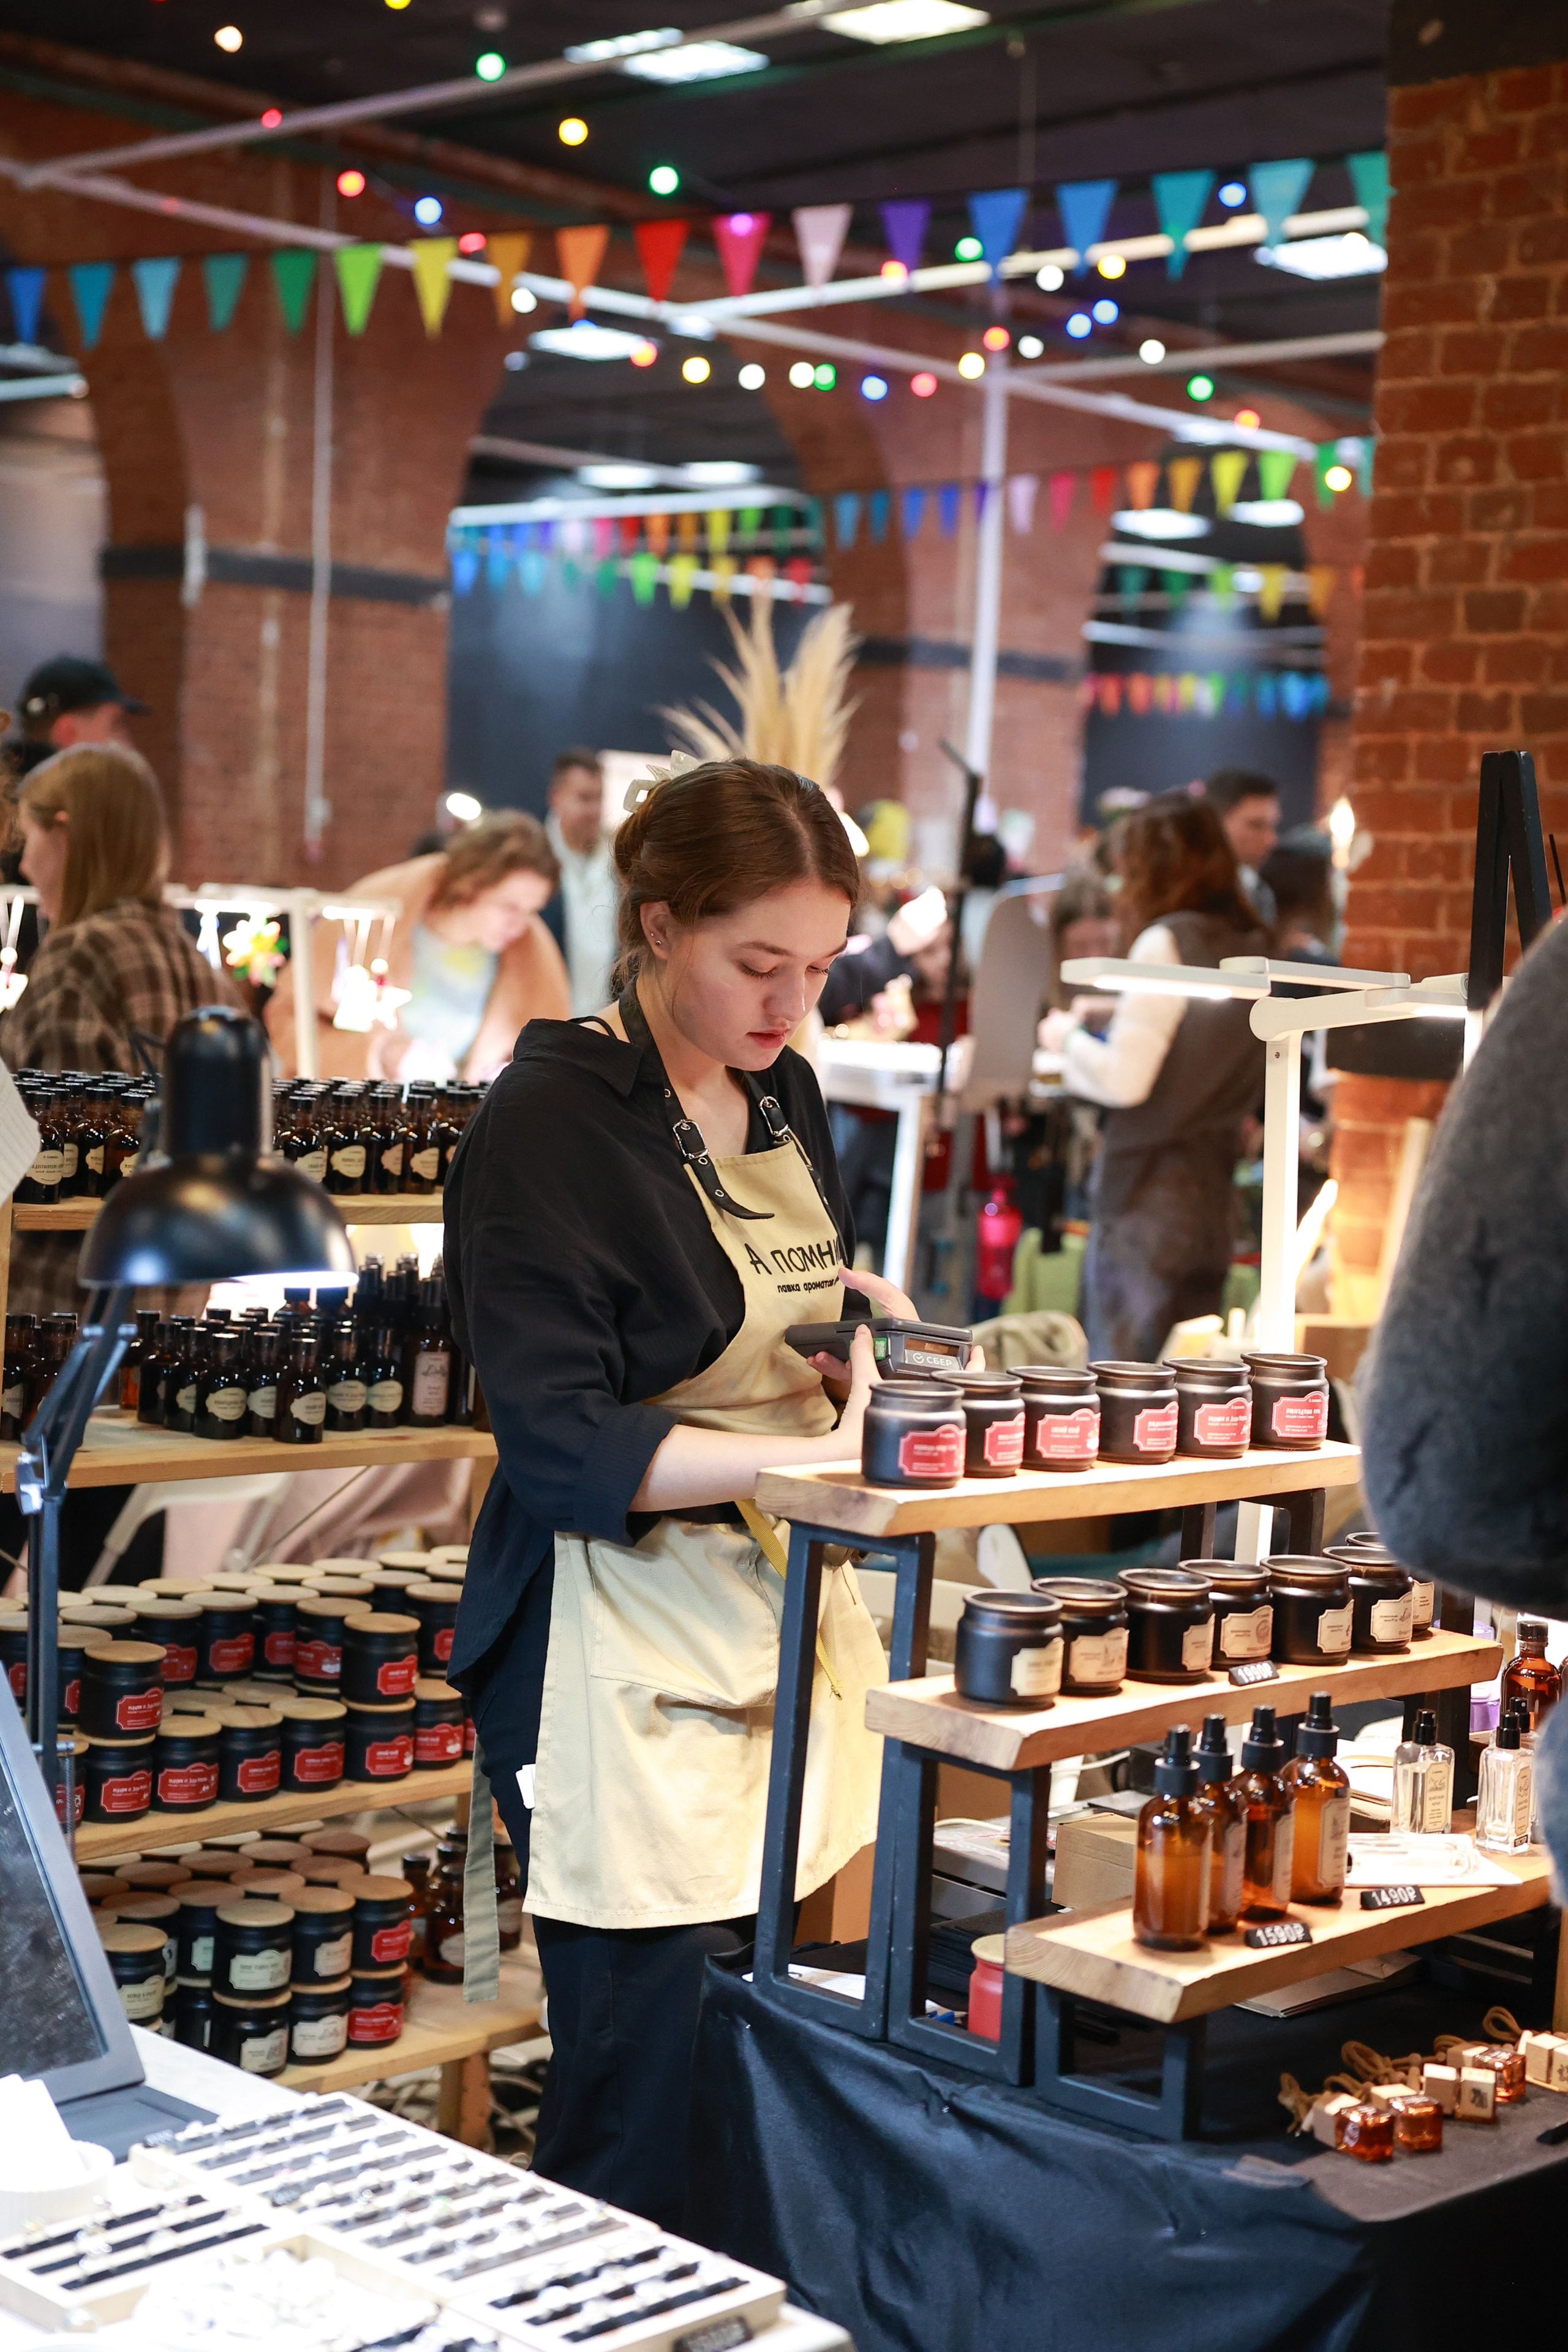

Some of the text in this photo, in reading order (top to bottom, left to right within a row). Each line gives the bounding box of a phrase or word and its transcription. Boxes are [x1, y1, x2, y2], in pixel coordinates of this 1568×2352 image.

[744, 1236, 841, 1275] А ПОМНИ
[777, 1283, 801, 1293] лавка
[926, 1356, 952, 1366] СБЕР
